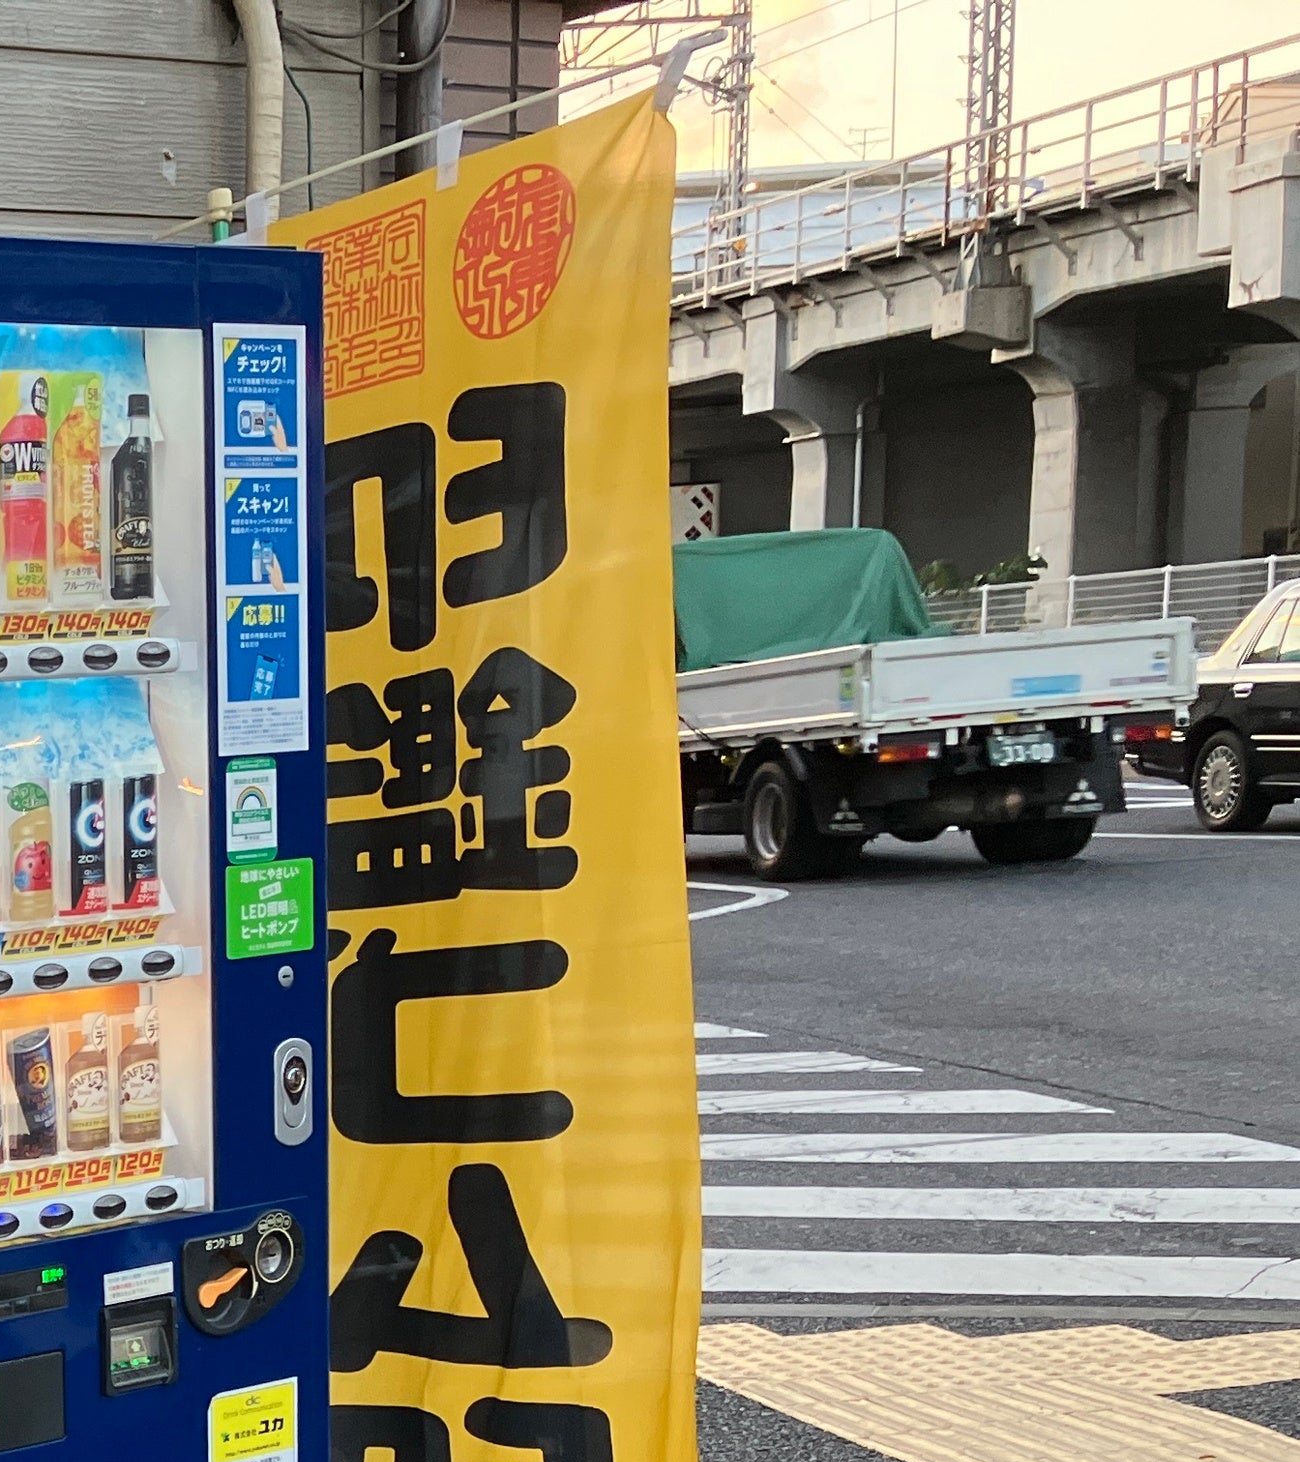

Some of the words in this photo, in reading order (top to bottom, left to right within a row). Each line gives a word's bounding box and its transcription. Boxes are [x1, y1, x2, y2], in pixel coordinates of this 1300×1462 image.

[237, 356, 287, 373] チェック!
[237, 497, 289, 514] スキャン!
[83, 522, 94, 550] TEA
[2, 614, 49, 633] 130円
[56, 612, 101, 631] 140円
[107, 611, 152, 629] 140円
[62, 923, 107, 942] 140円
[115, 916, 159, 935] 140円
[241, 917, 299, 940] ヒートポンプ
[10, 928, 54, 946] 110円
[66, 1160, 111, 1180] 120円
[118, 1152, 163, 1170] 120円
[14, 1167, 62, 1188] 110円
[258, 1418, 284, 1434] ユカ
